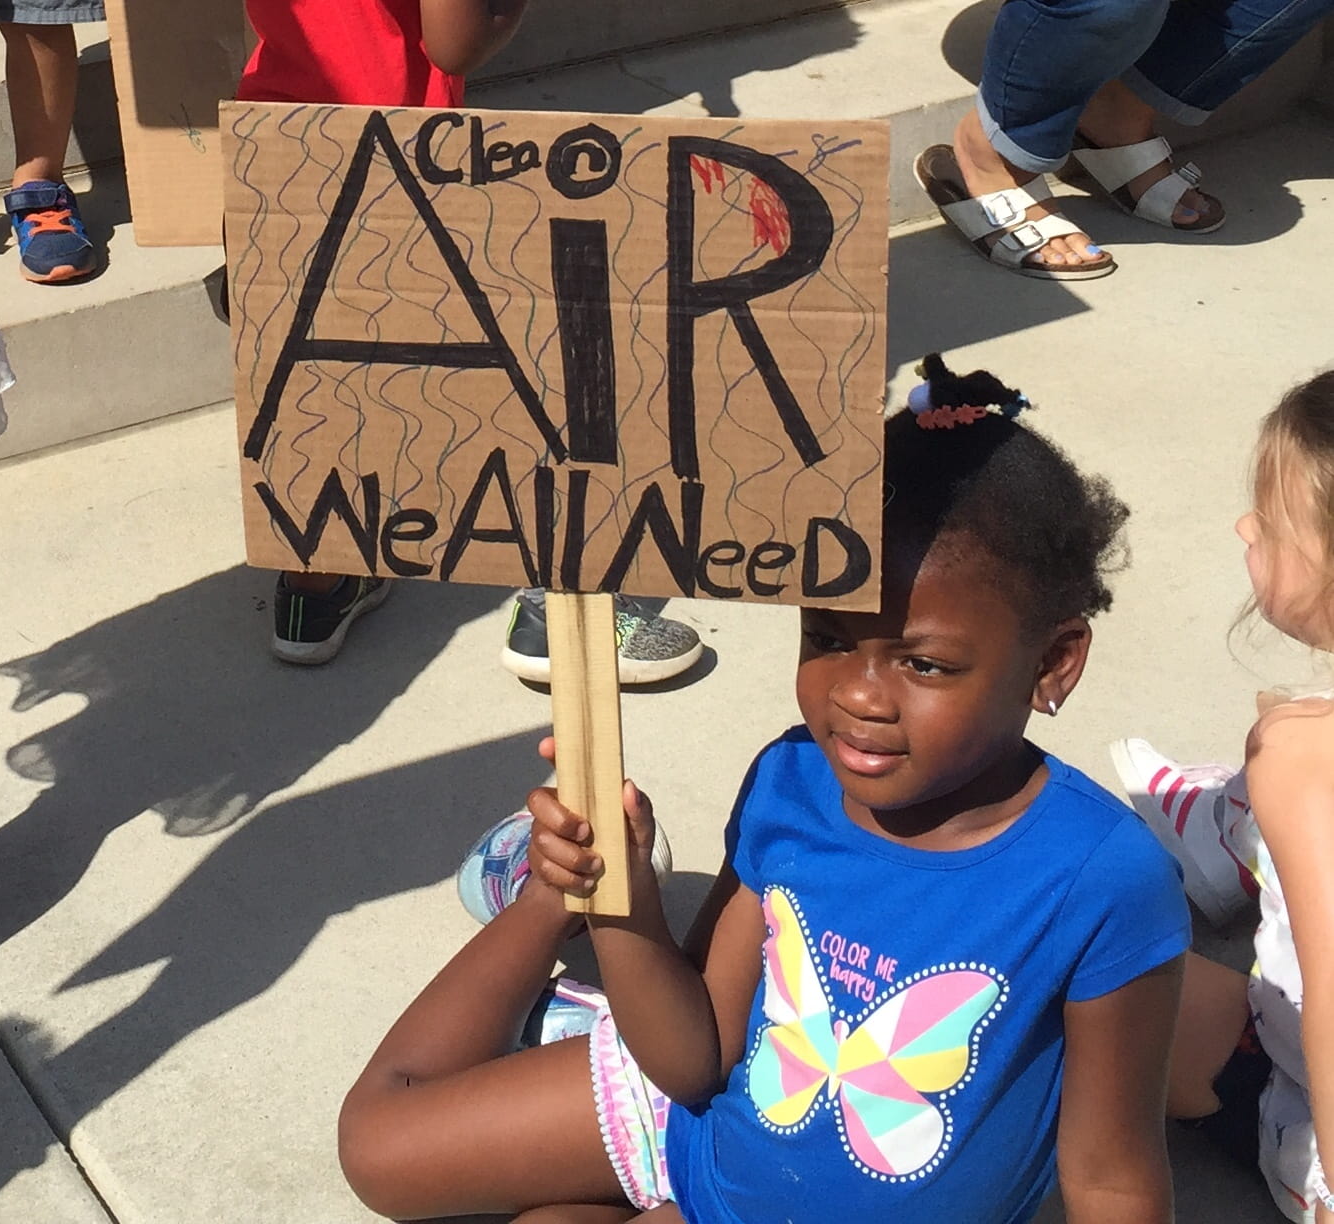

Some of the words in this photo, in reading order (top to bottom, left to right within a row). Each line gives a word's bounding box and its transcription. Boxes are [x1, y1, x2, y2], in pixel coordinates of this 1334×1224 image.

[820, 930, 870, 970] COLOR
[874, 954, 898, 983] ME
[830, 958, 876, 1002] happy
